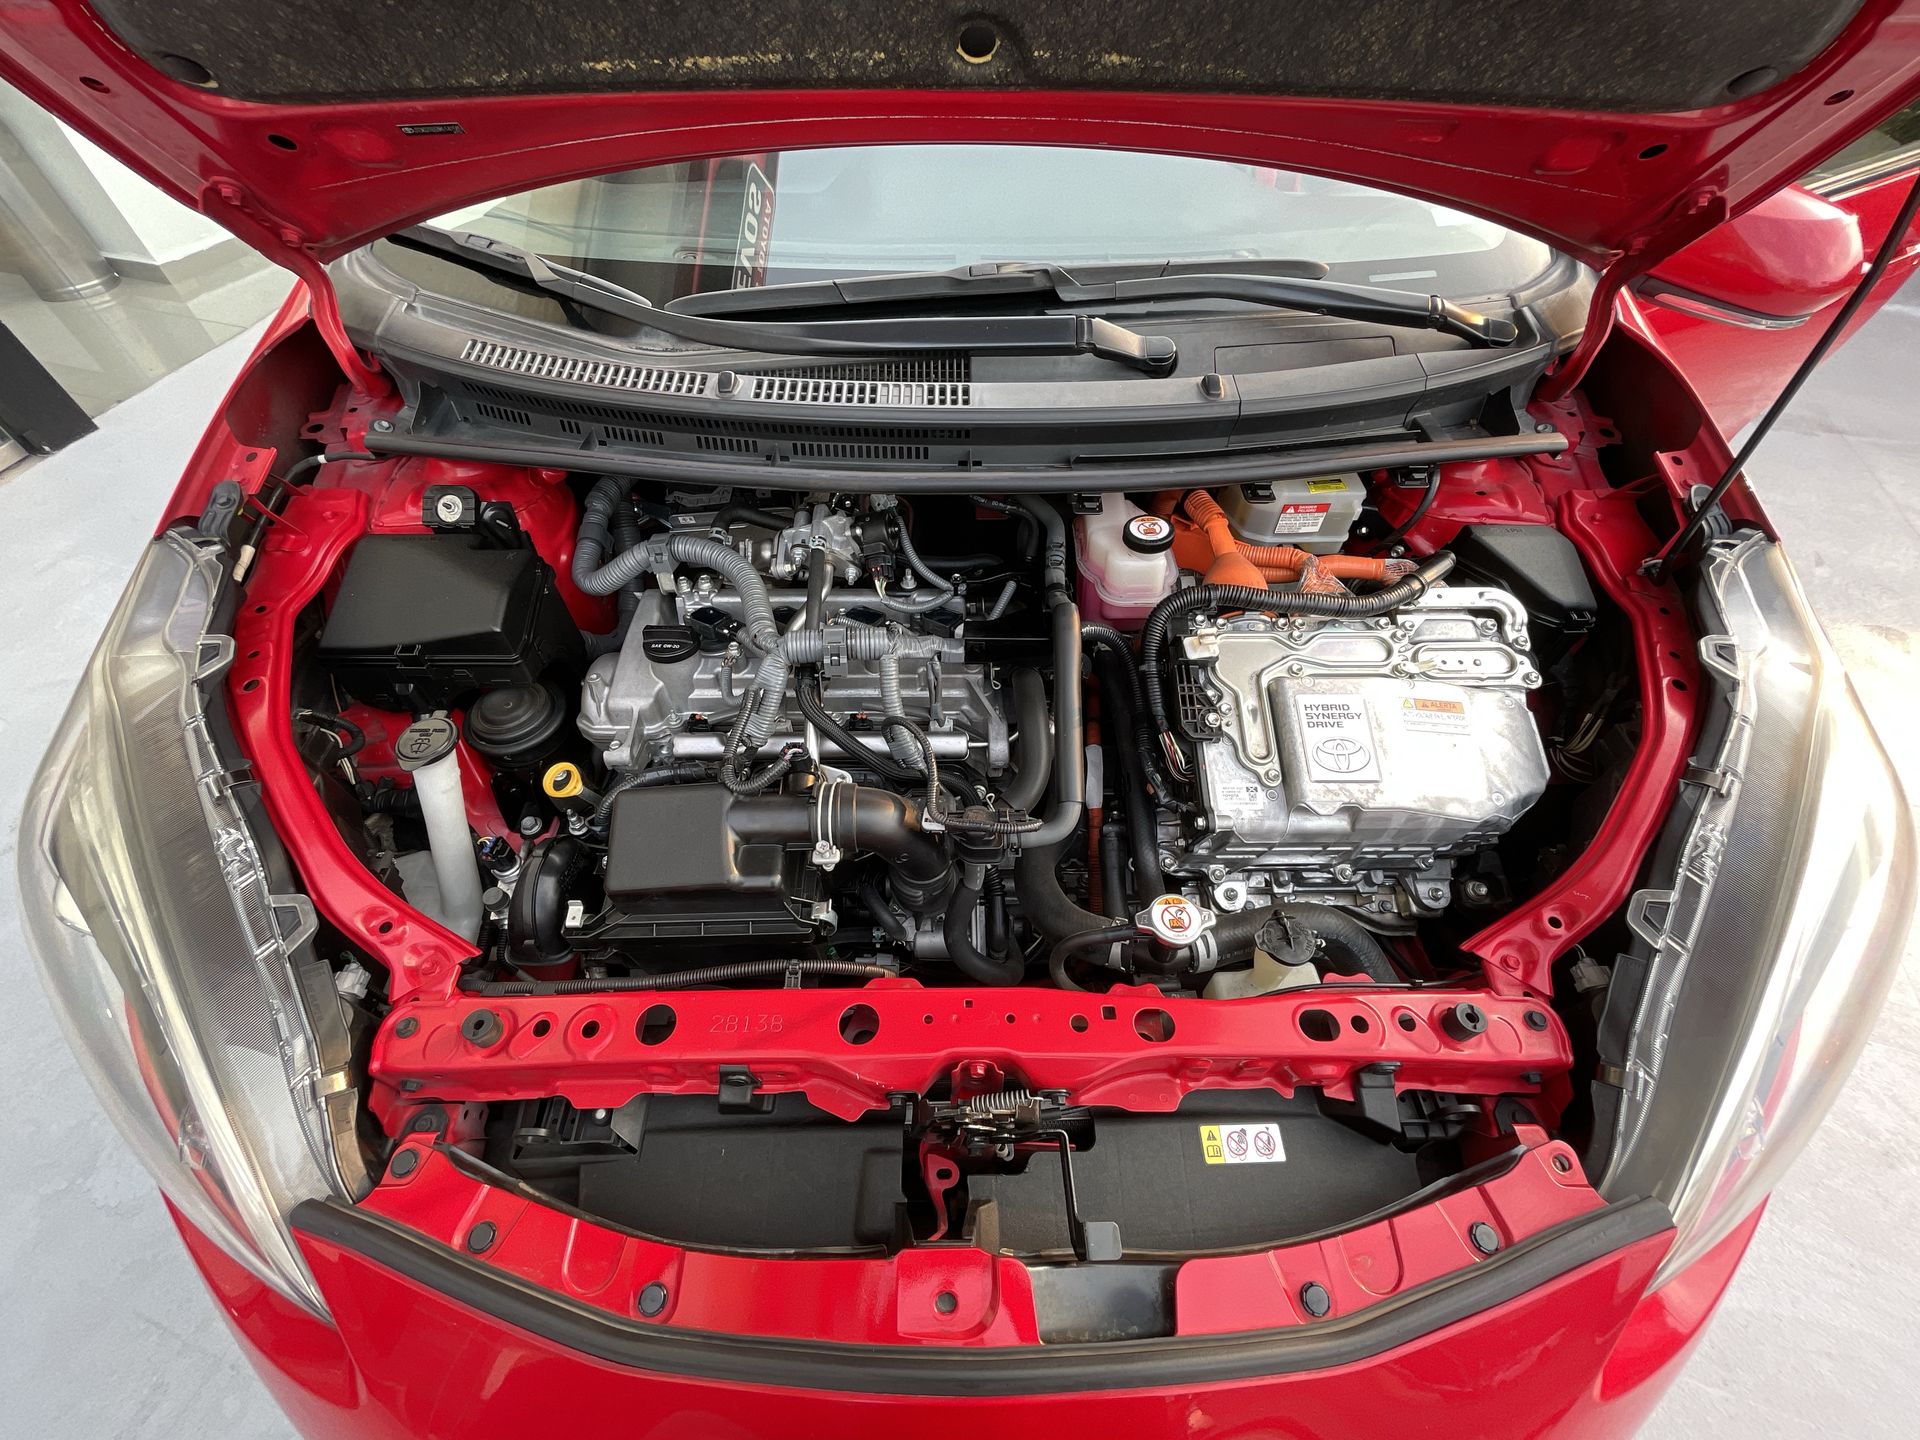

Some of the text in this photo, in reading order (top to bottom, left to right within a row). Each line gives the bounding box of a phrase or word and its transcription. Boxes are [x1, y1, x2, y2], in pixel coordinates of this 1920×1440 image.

[1304, 703, 1350, 712] HYBRID
[1305, 712, 1362, 720] SYNERGY
[709, 1014, 784, 1033] 28138
